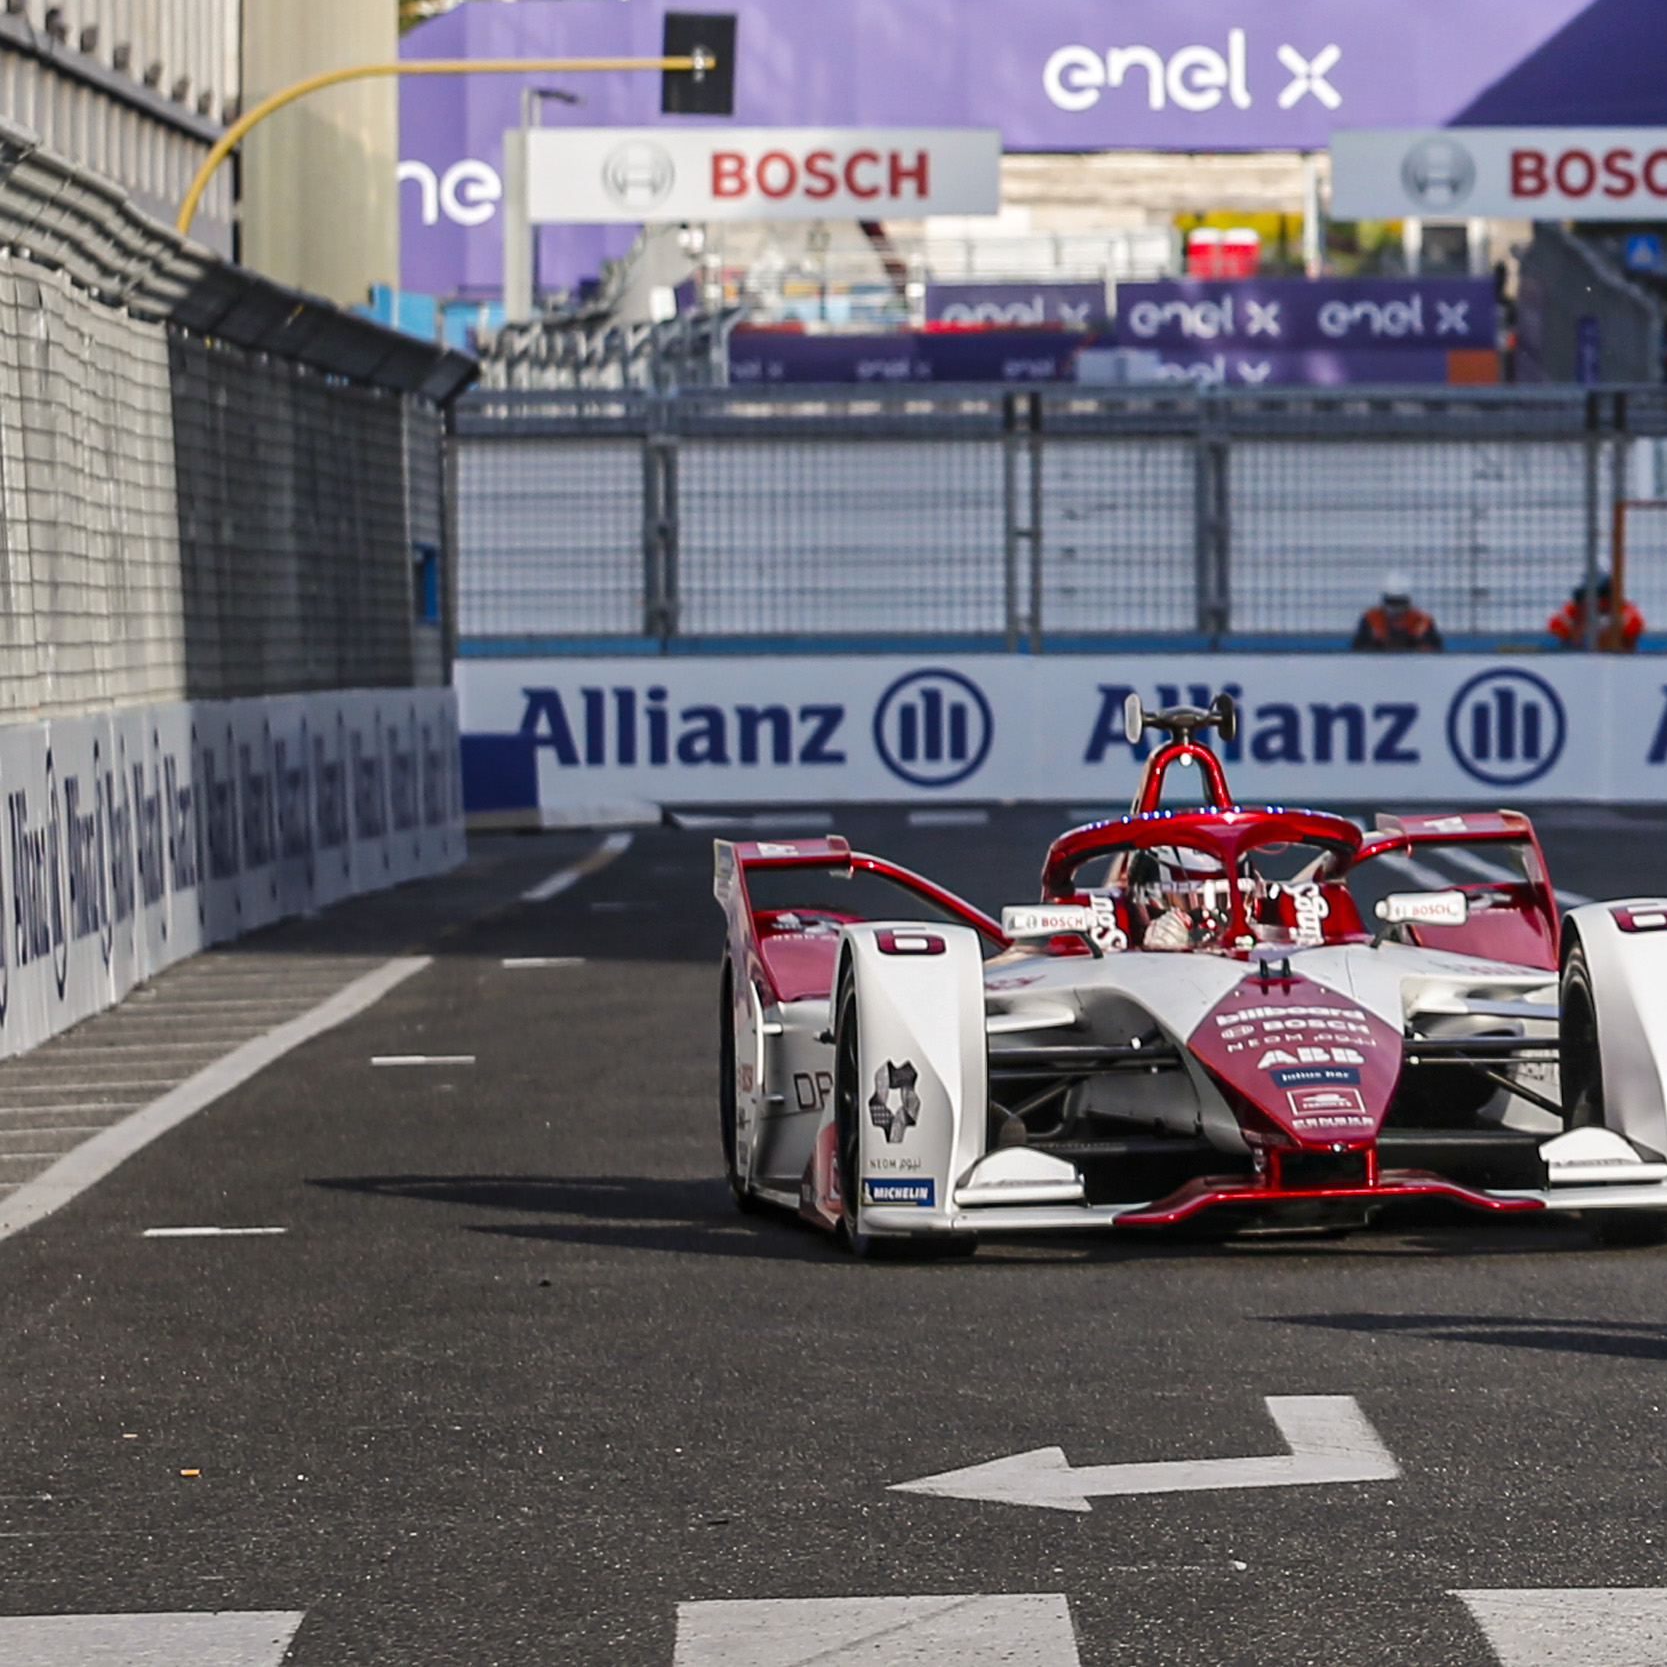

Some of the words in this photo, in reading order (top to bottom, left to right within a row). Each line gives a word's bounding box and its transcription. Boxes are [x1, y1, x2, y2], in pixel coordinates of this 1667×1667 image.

[1042, 27, 1251, 111] enel
[710, 150, 930, 200] BOSCH
[1129, 292, 1235, 338] enel
[1318, 292, 1425, 336] enel
[517, 684, 847, 767] Allianz
[1413, 903, 1450, 916] BOSCH
[1041, 916, 1083, 928] BOSCH
[1215, 1006, 1367, 1027] billboard
[1262, 1019, 1370, 1035] BOSCH
[1227, 1033, 1304, 1053] NEOM
[1257, 1046, 1365, 1069] ABB
[873, 1186, 929, 1201] MICHELIN
